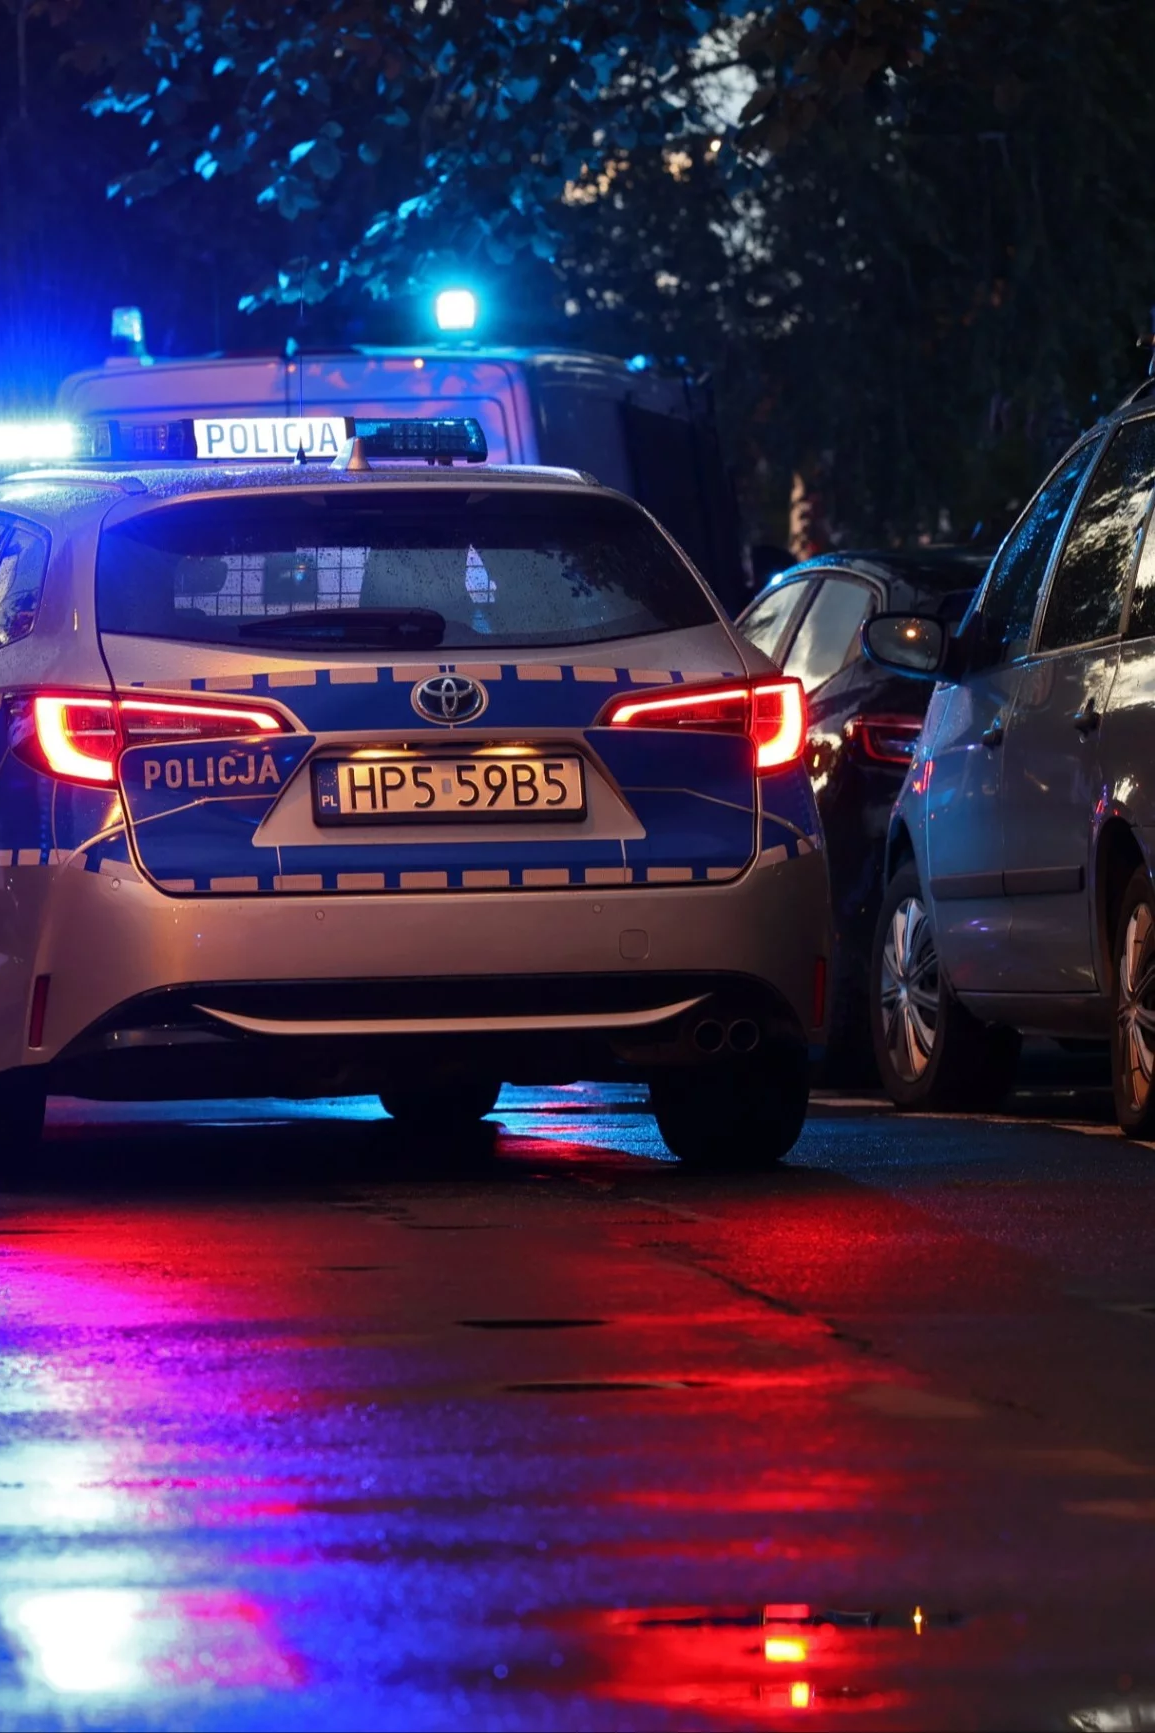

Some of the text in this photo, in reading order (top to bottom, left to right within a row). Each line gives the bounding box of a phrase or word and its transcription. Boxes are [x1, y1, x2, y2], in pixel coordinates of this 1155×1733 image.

[206, 423, 338, 454] POLICJA
[144, 754, 281, 790] POLICJA
[456, 763, 567, 807] 59B5
[321, 794, 338, 808] PL
